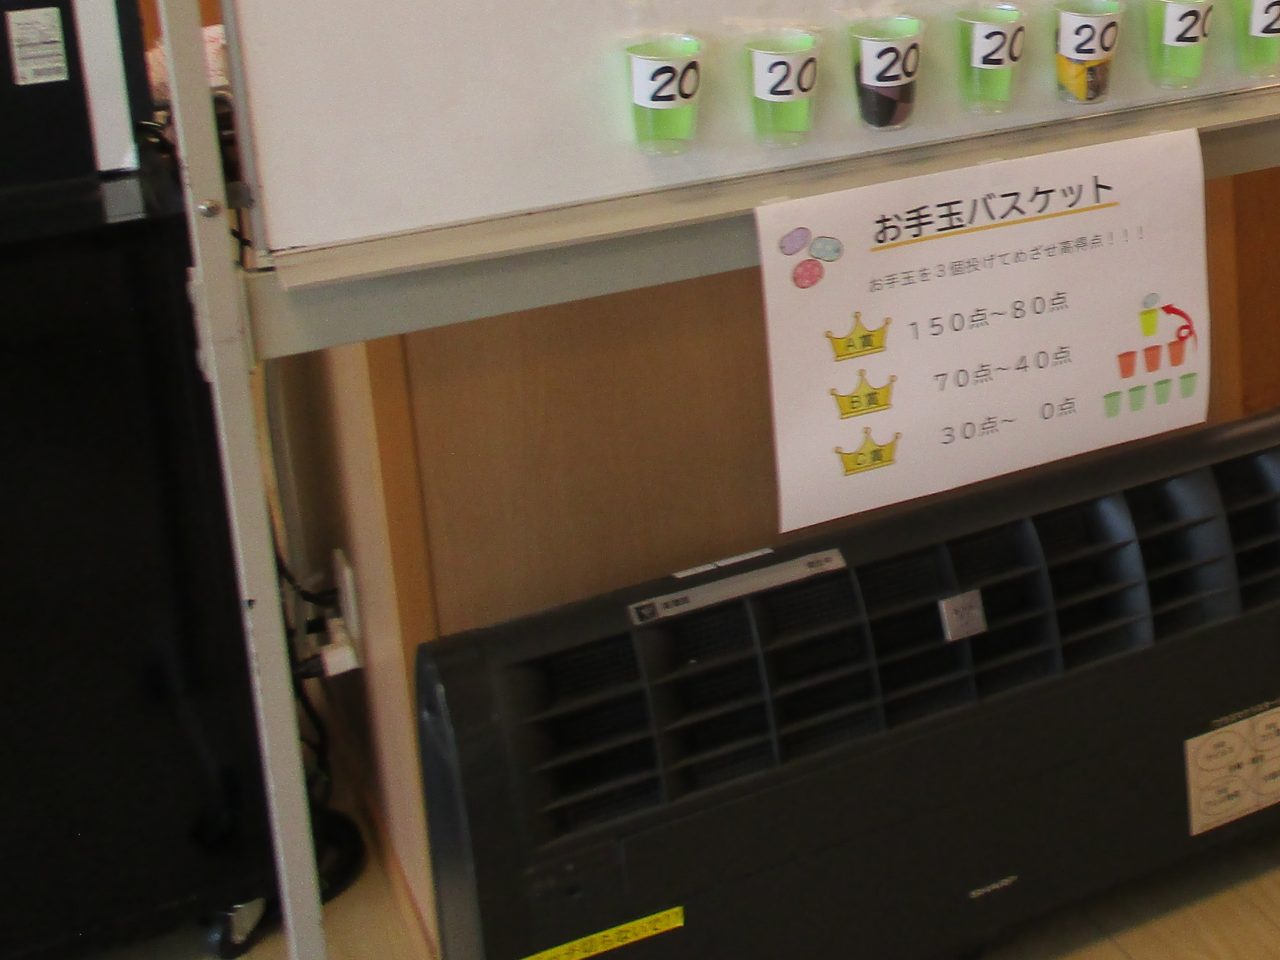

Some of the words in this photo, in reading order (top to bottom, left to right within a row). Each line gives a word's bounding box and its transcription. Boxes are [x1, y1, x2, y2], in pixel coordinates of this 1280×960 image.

[982, 26, 1025, 65] 20
[1074, 21, 1119, 55] 20
[650, 60, 700, 102] 20
[767, 57, 817, 96] 20
[875, 43, 920, 82] 20
[873, 175, 1113, 244] お手玉バスケット
